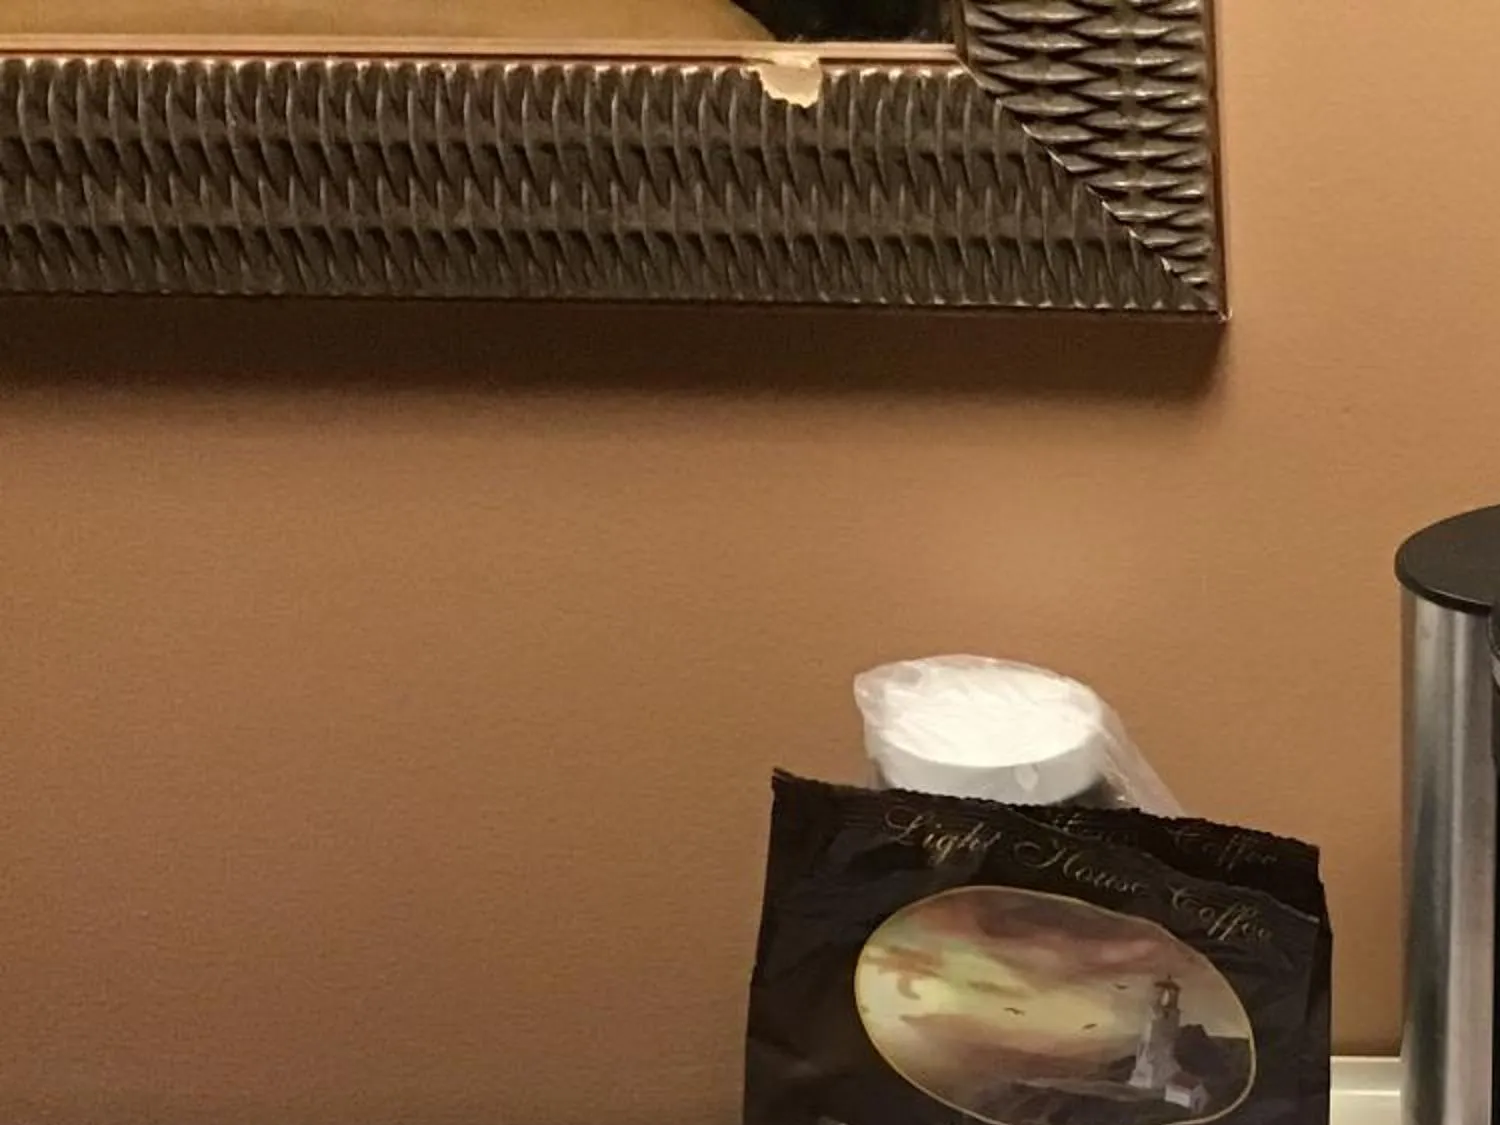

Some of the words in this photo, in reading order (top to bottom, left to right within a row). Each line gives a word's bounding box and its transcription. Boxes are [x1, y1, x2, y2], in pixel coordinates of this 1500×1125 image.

[884, 804, 1001, 865] Light
[1013, 838, 1150, 897] House
[1165, 882, 1274, 942] Coffee
